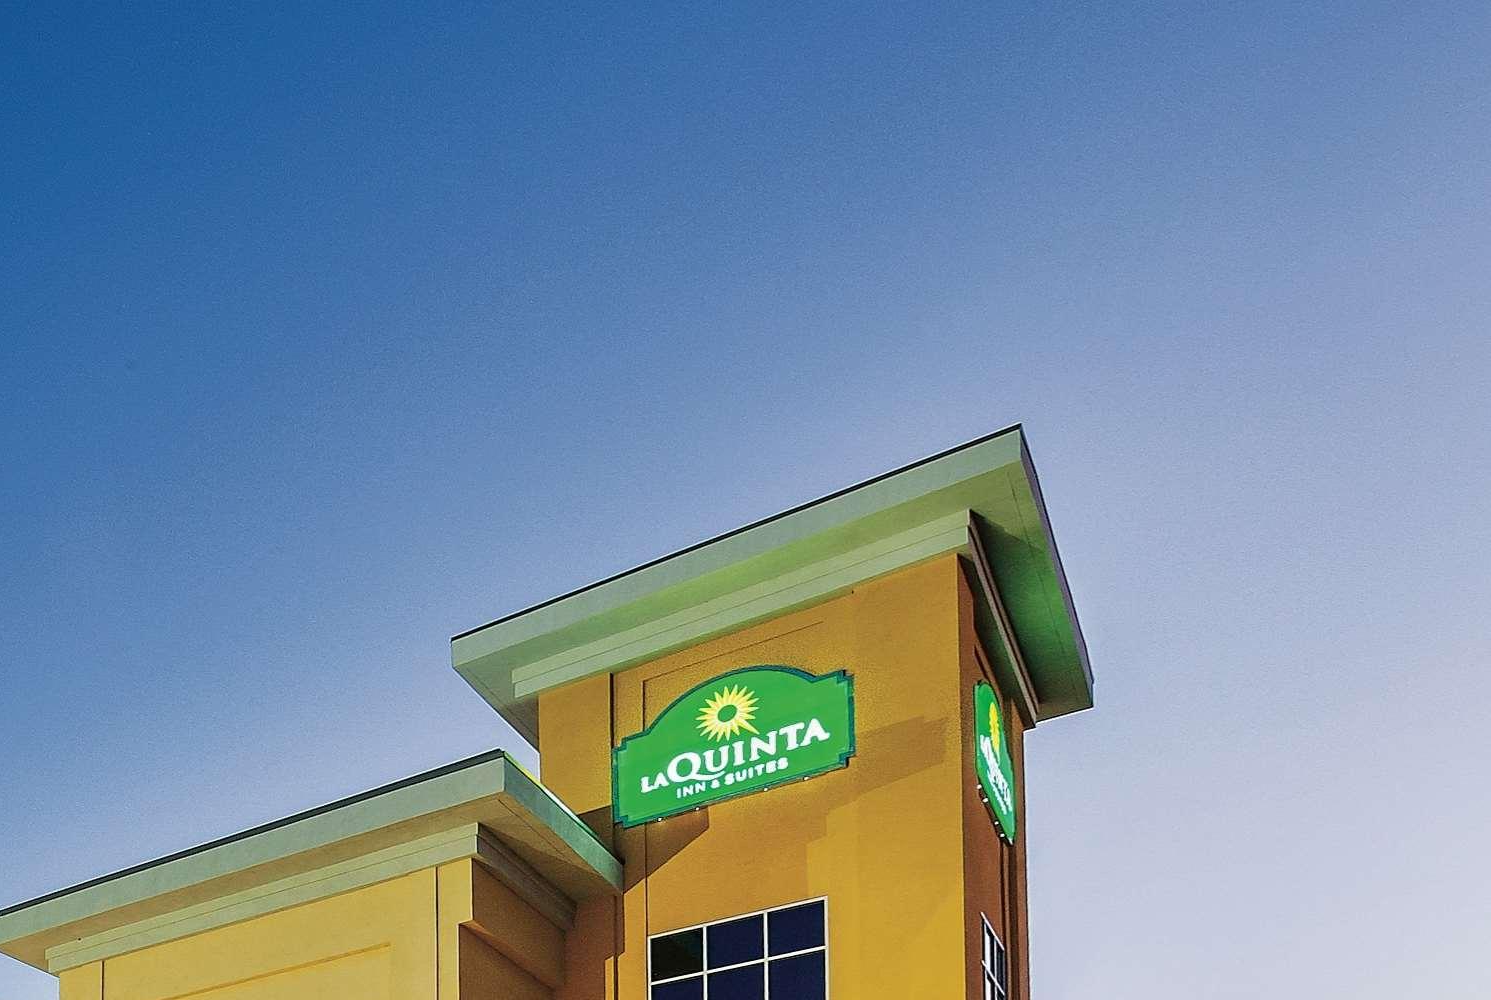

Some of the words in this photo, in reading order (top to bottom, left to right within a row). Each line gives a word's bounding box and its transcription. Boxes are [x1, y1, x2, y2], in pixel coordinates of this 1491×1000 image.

[667, 718, 830, 782] QUINTA
[676, 781, 706, 799] INN
[710, 779, 720, 789] &
[724, 757, 789, 786] SUITES
